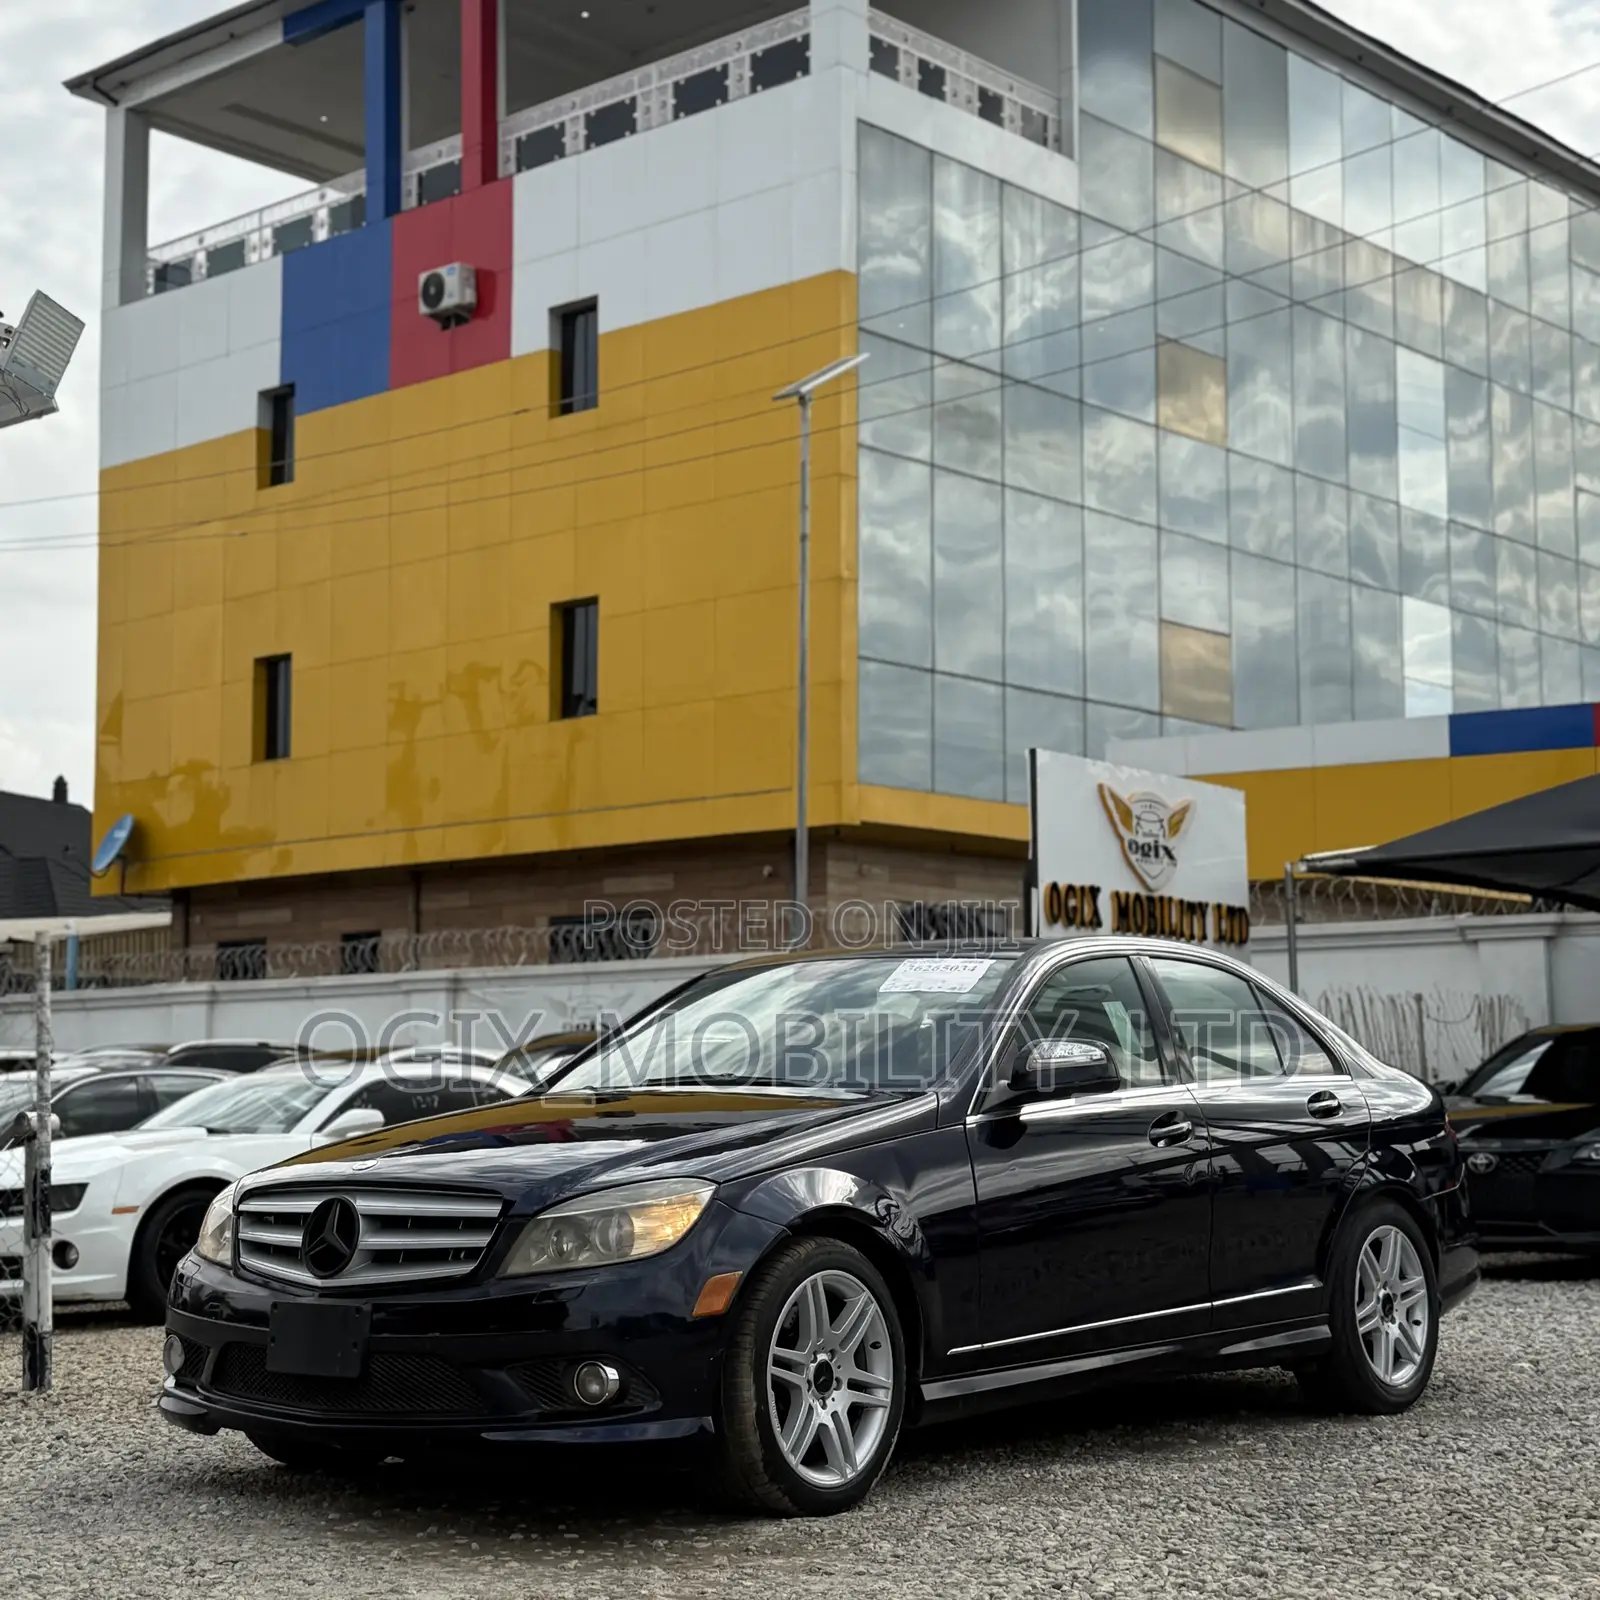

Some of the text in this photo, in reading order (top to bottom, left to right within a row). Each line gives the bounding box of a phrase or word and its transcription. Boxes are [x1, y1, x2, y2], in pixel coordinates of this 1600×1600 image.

[1044, 881, 1249, 946] OGIX MOBILITY LTD
